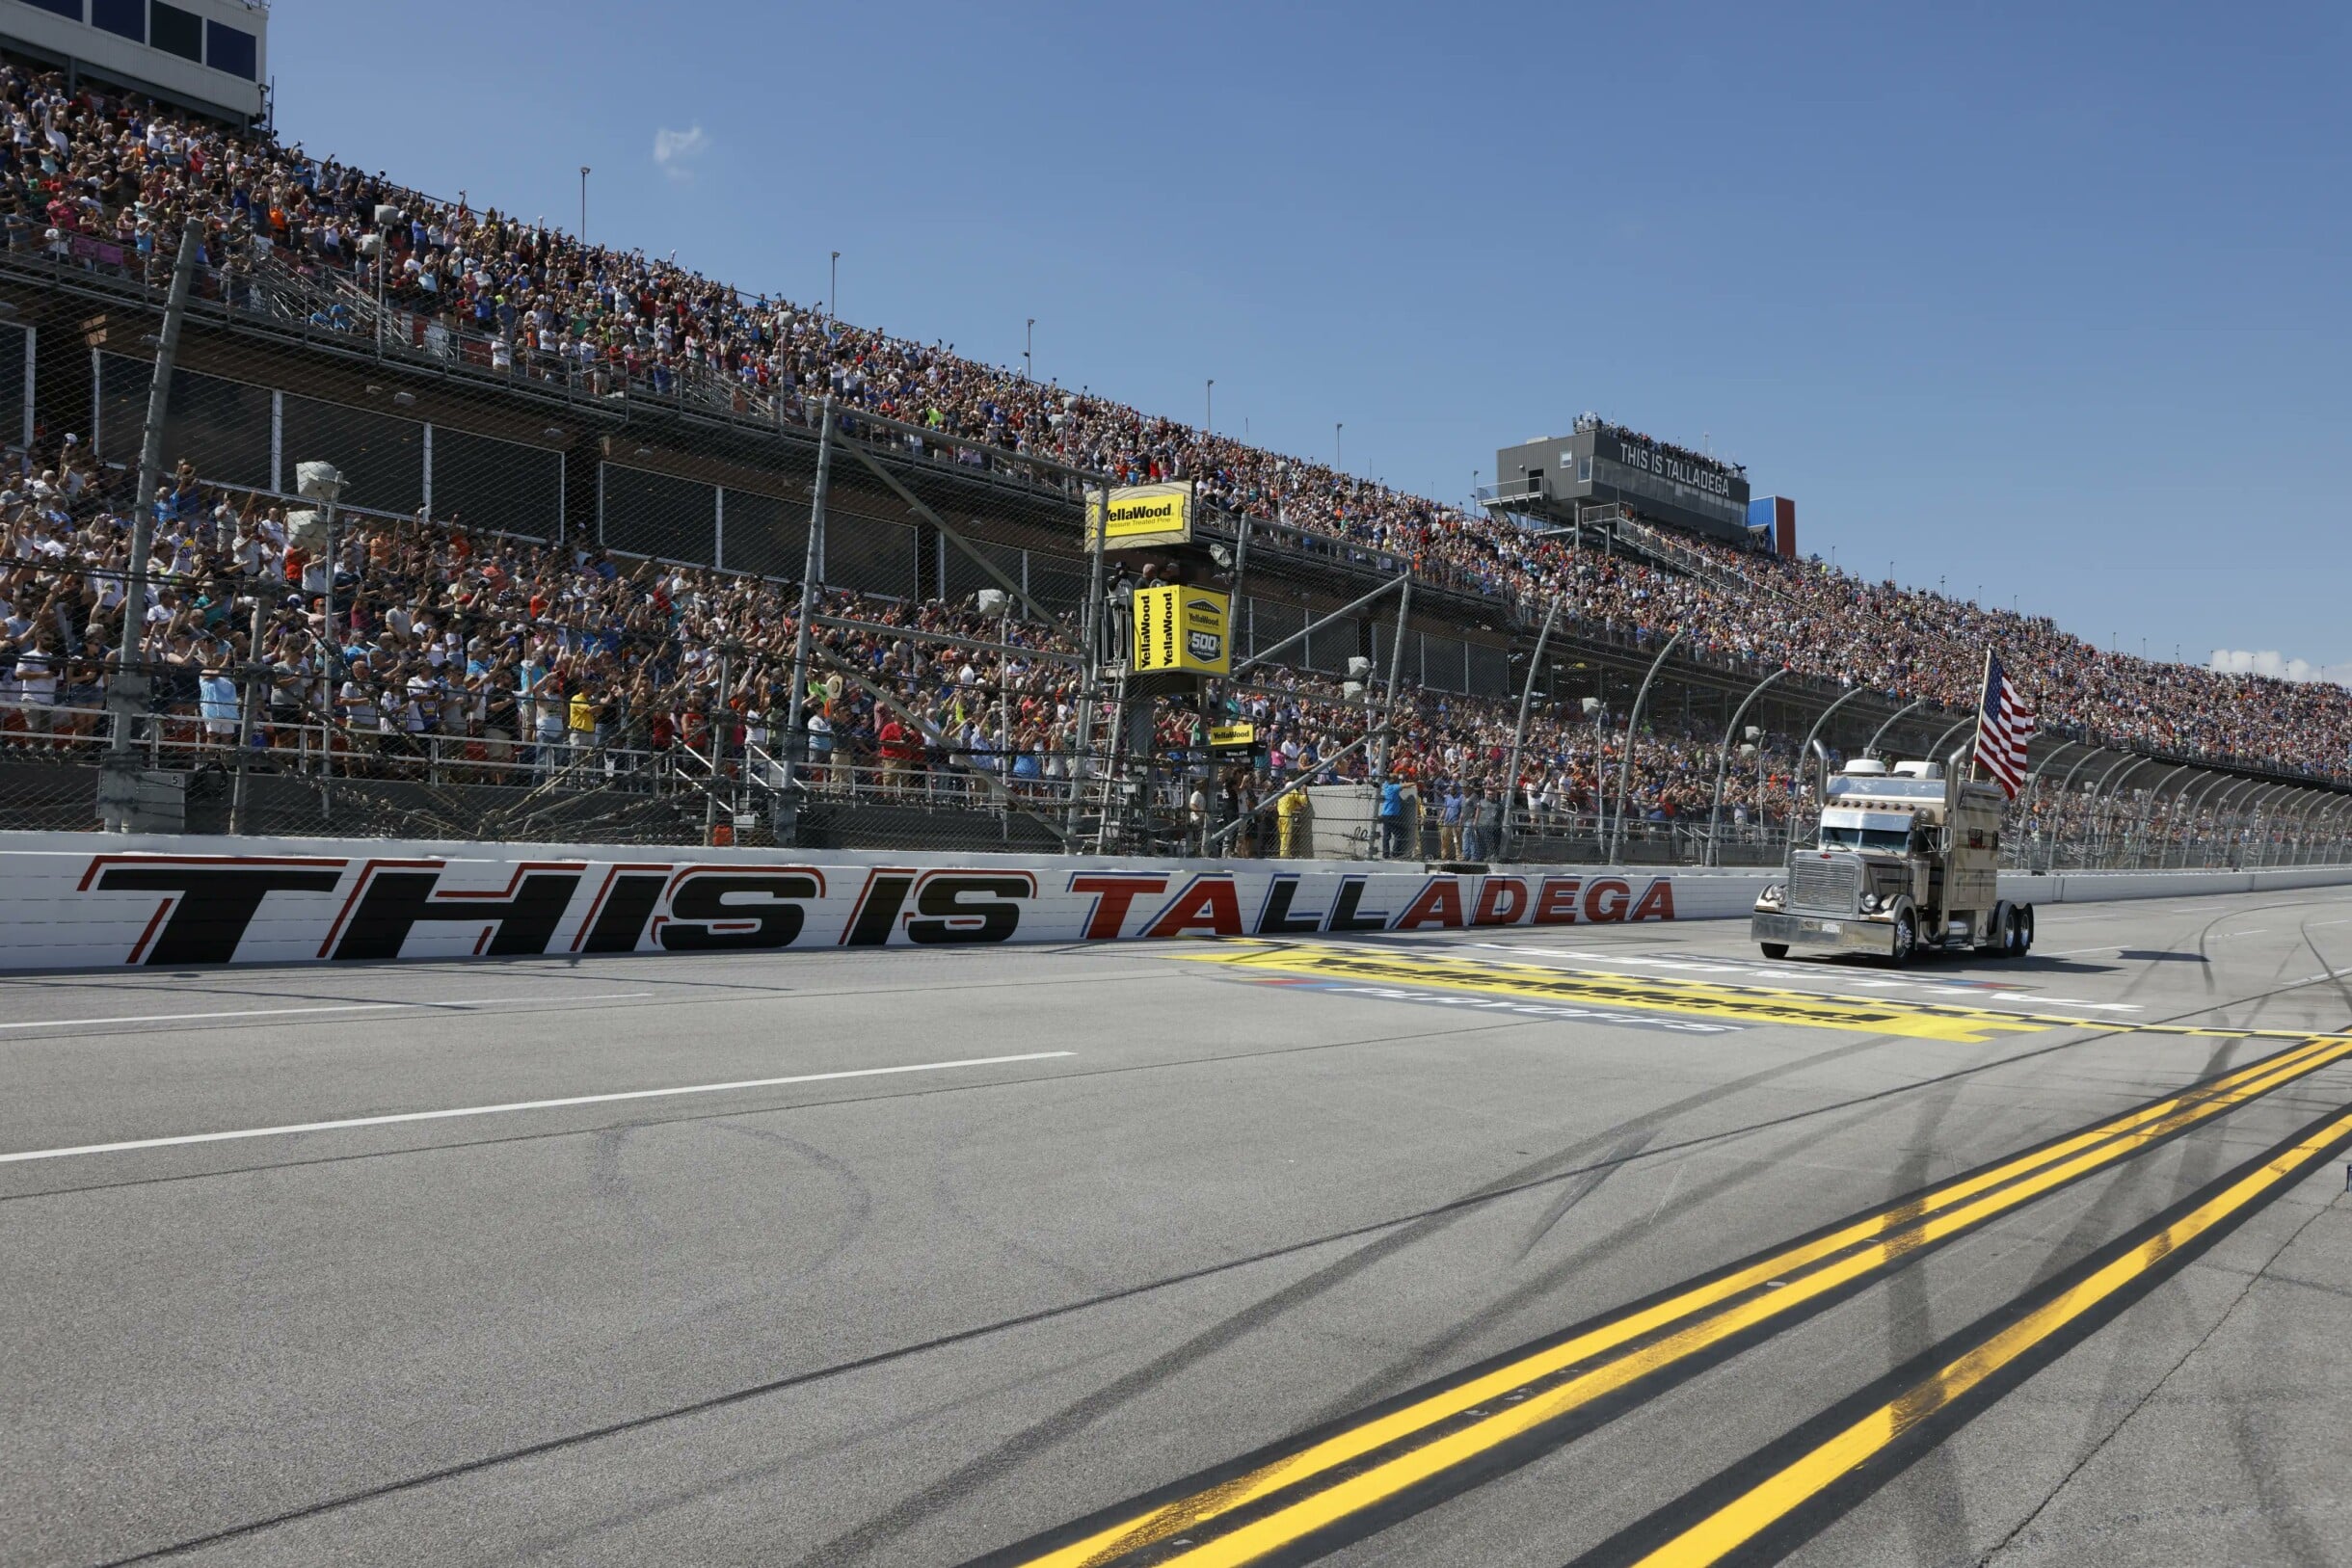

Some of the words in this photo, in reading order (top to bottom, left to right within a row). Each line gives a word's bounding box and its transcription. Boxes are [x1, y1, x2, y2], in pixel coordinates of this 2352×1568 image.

[1620, 442, 1648, 469] THIS
[1651, 453, 1663, 474] IS
[1665, 459, 1730, 497] TALLADEGA
[1141, 596, 1150, 669] YellaWood
[1163, 593, 1173, 666] YellaWood
[1189, 612, 1219, 626] YellaWood
[1191, 632, 1217, 651] 500
[1214, 731, 1250, 740] YellaWood
[76, 855, 826, 965] THIS
[840, 868, 1038, 946] IS
[1065, 871, 1675, 938] TALLADEGA
[1313, 957, 1903, 1023] YellaWood
[1323, 987, 1748, 1033] PLAYOFFS
